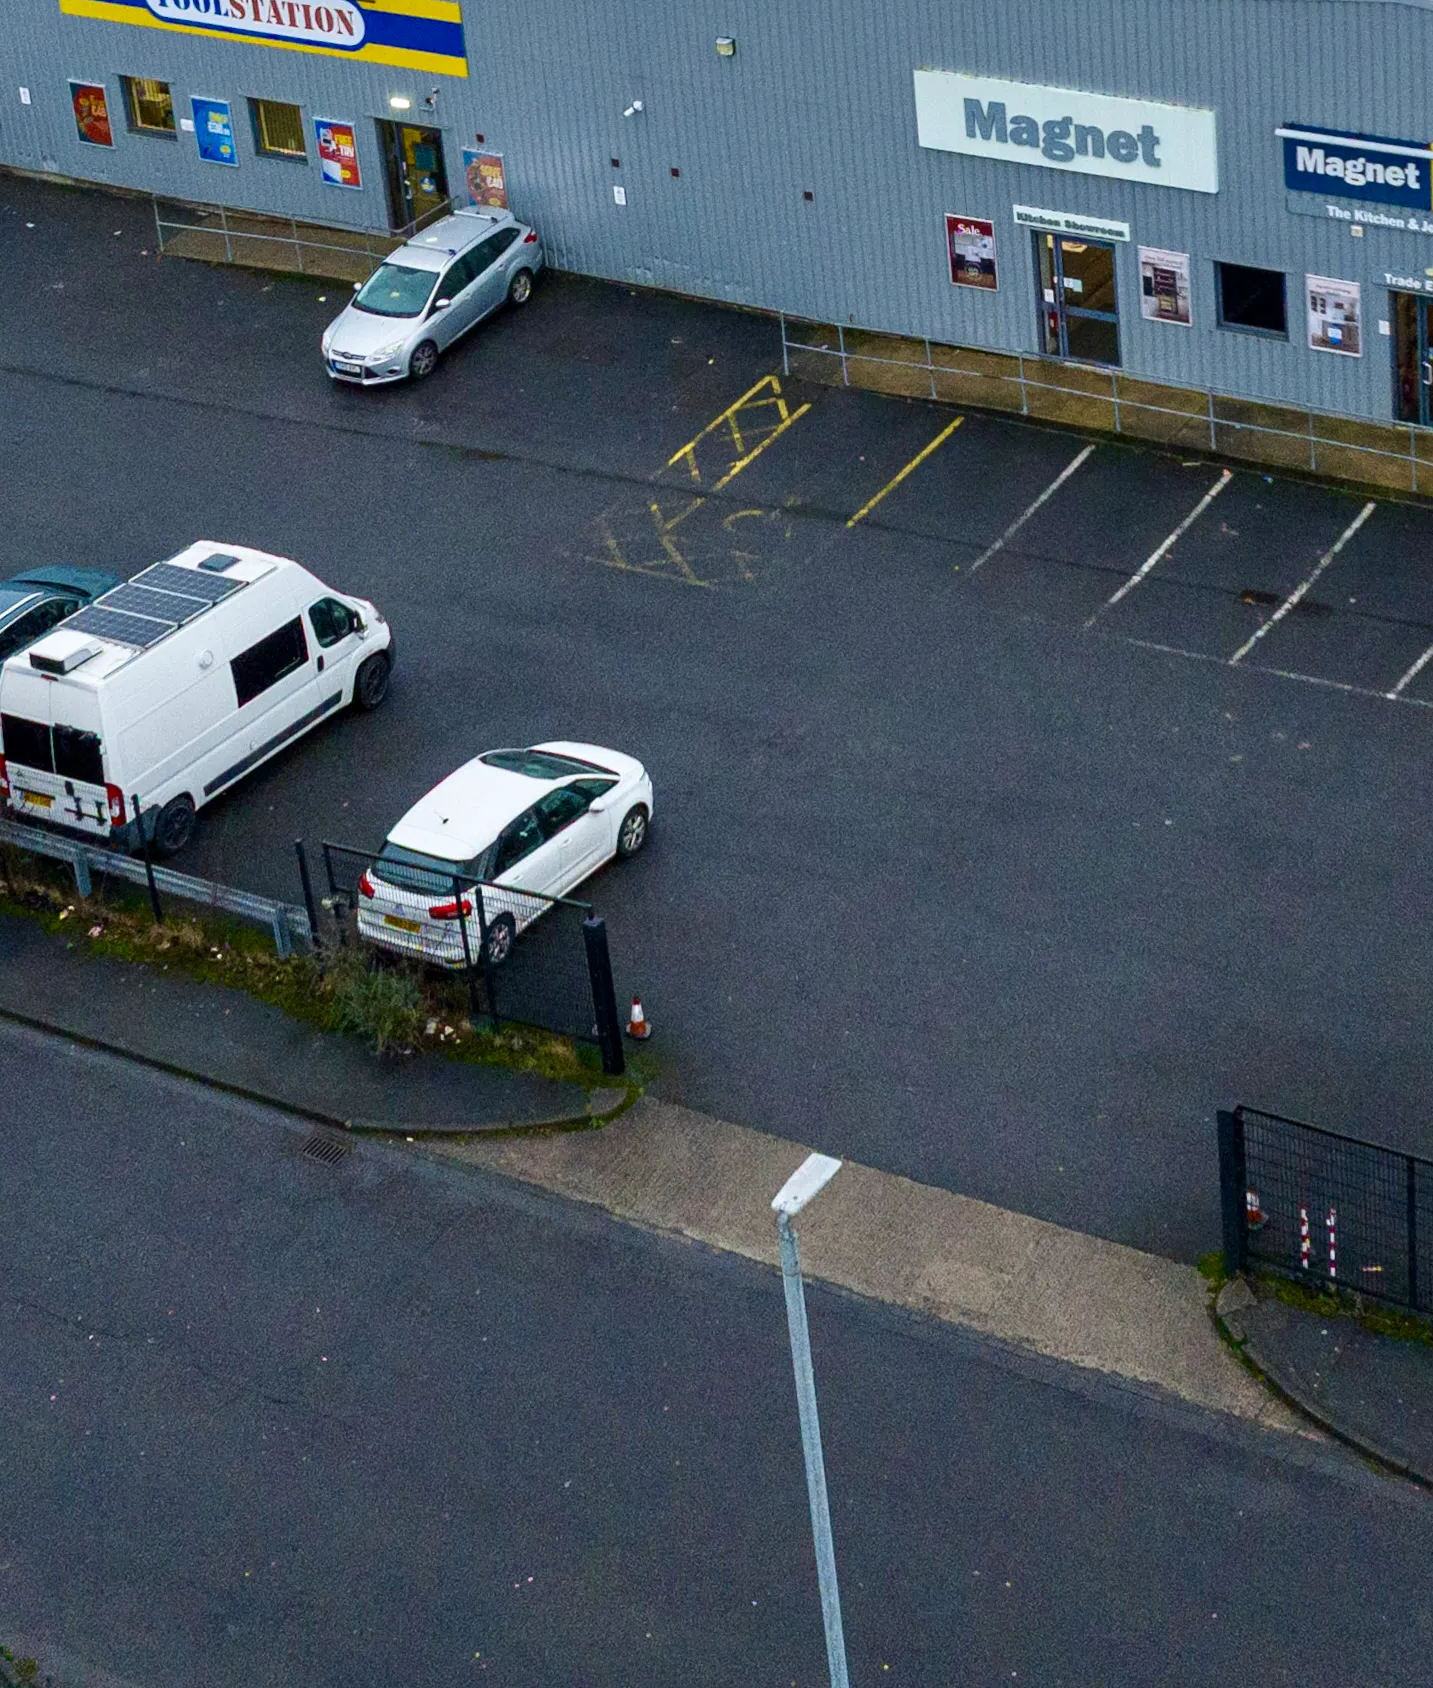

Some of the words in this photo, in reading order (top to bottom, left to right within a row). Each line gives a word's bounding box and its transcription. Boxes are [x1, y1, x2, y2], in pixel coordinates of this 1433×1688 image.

[963, 97, 1161, 167] Magnet
[1296, 146, 1420, 189] Magnet
[957, 223, 980, 237] Sale
[1016, 212, 1061, 227] Kitchen
[1064, 219, 1125, 238] Showroom
[1326, 205, 1351, 220] The
[1354, 209, 1405, 229] Kitchen
[1407, 218, 1419, 230] &
[1384, 273, 1422, 290] Trade
